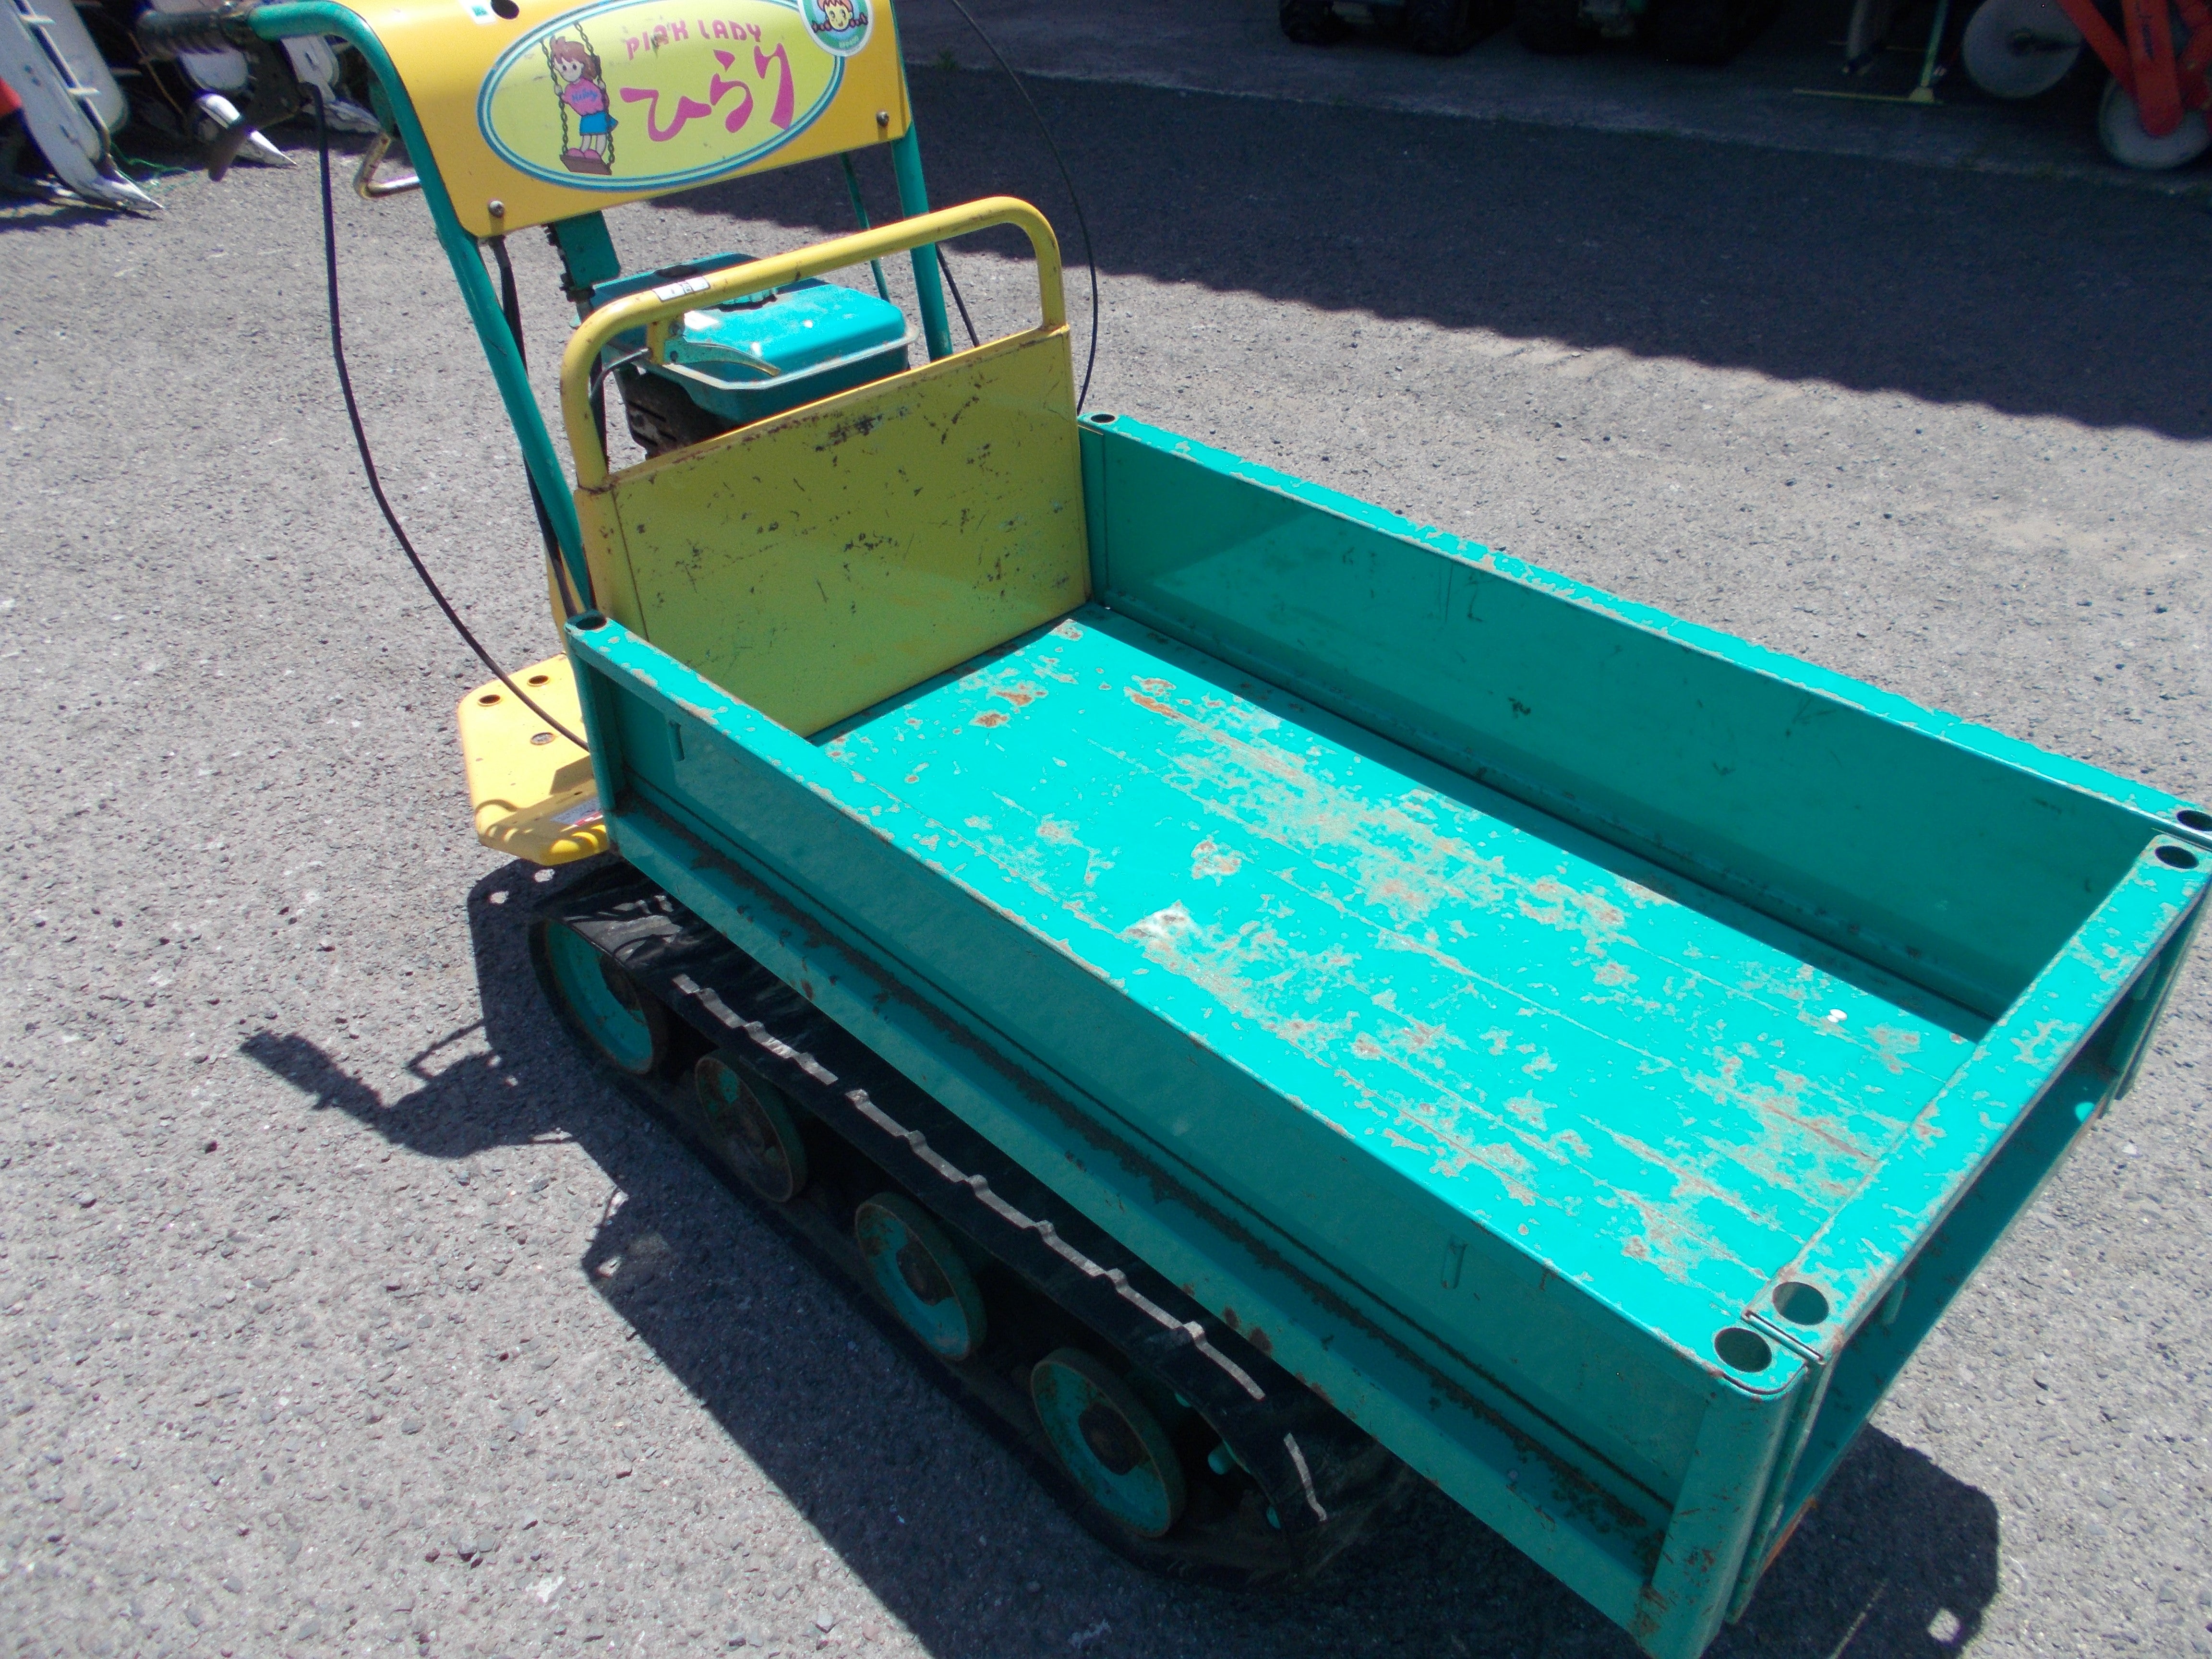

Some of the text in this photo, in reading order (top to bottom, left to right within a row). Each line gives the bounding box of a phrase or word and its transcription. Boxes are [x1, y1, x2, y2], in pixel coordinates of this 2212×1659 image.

[697, 19, 762, 43] LADY
[619, 42, 794, 142] ひらり
